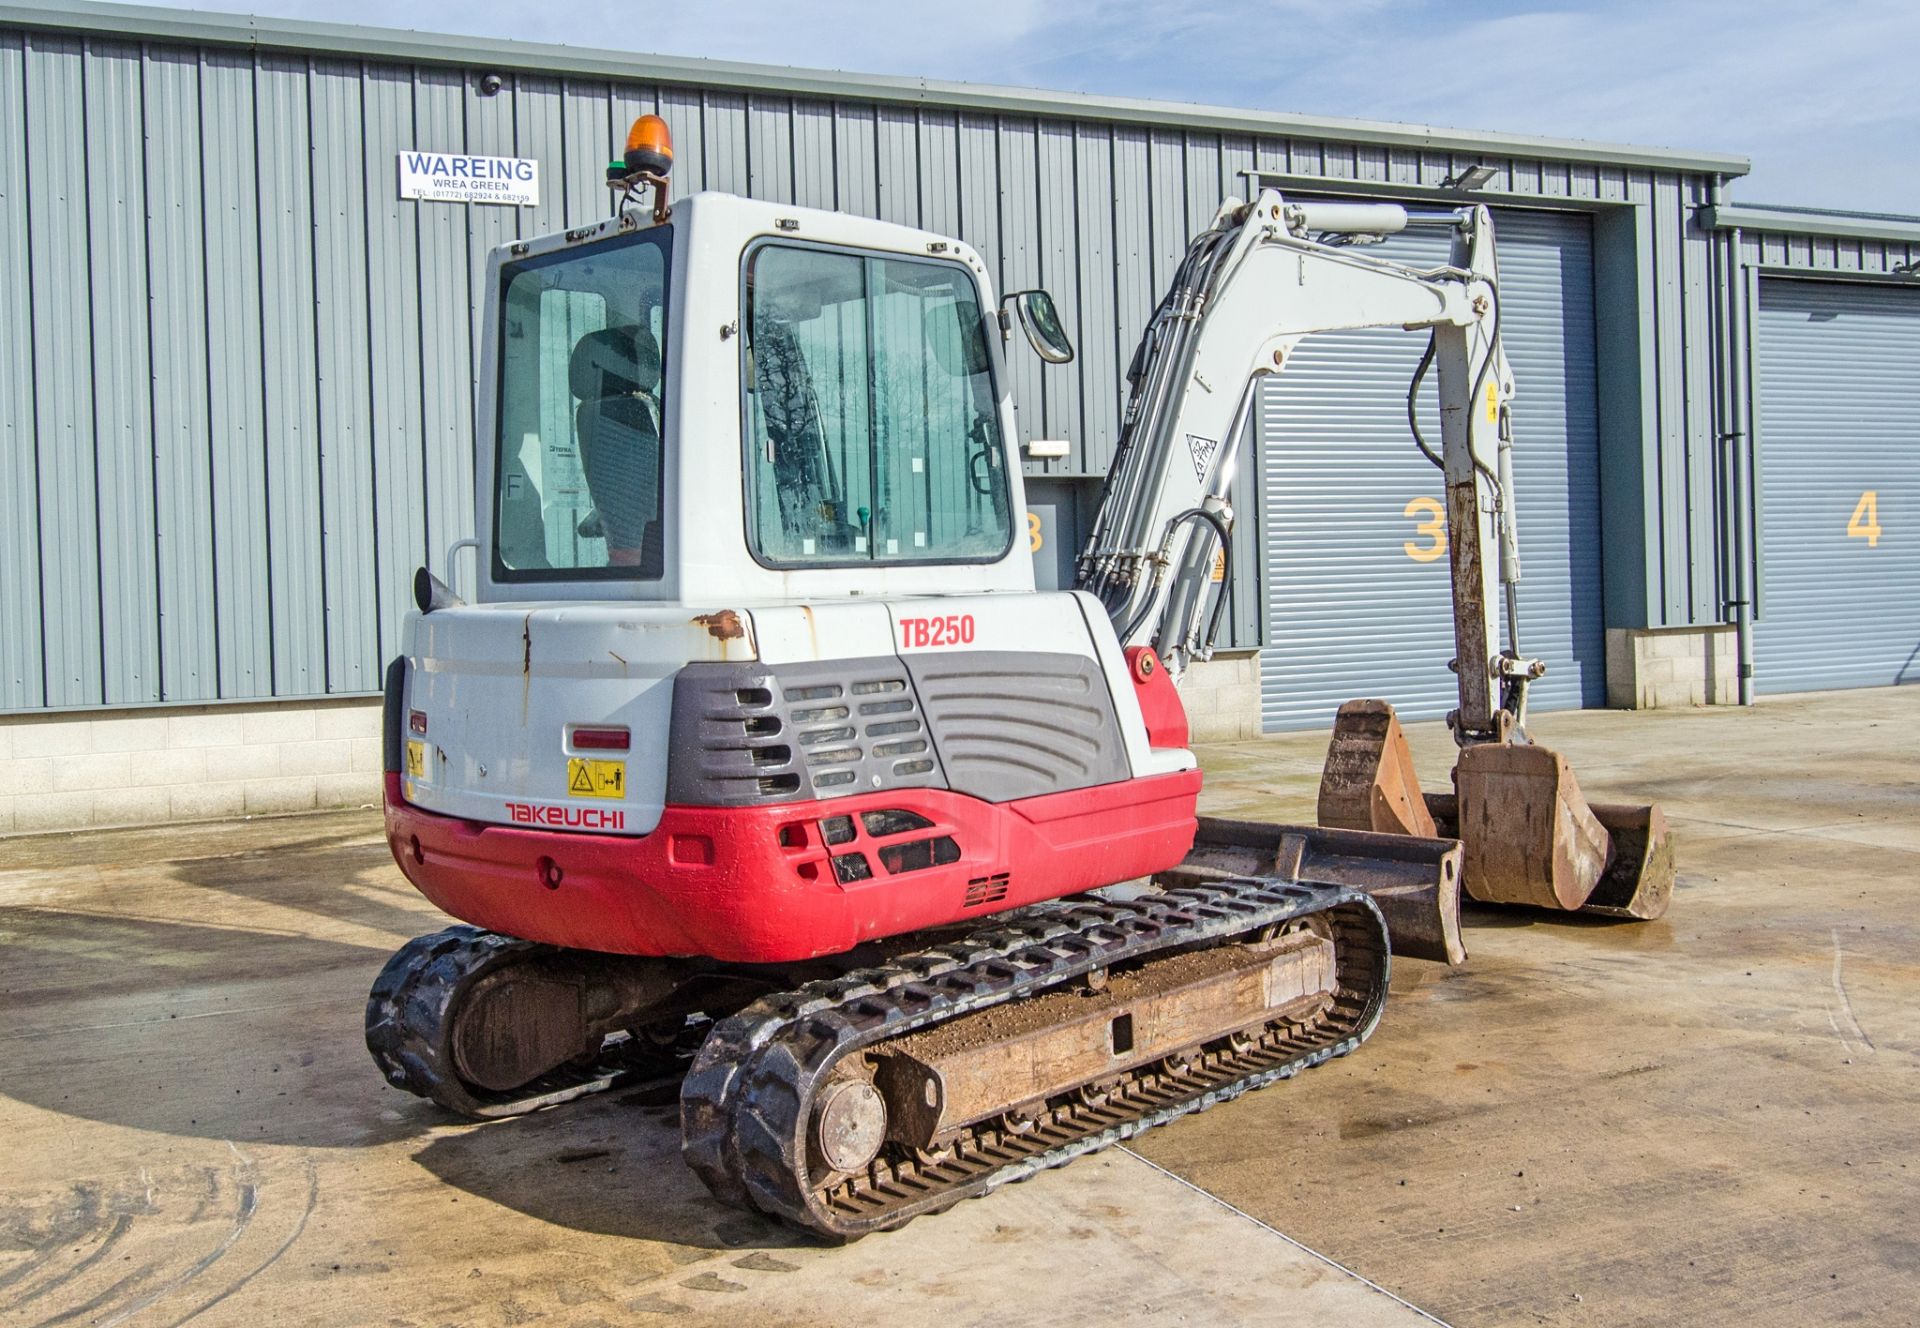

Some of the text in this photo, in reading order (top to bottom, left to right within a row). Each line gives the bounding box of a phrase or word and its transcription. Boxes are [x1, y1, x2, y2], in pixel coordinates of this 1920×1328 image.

[407, 154, 533, 181] WAREING
[433, 179, 509, 191] WREA GREEN
[433, 190, 462, 199] (01772)
[1403, 496, 1447, 563] 3
[1846, 490, 1882, 547] 4
[899, 614, 975, 648] TB250
[505, 803, 624, 830] TAKEUCHI
